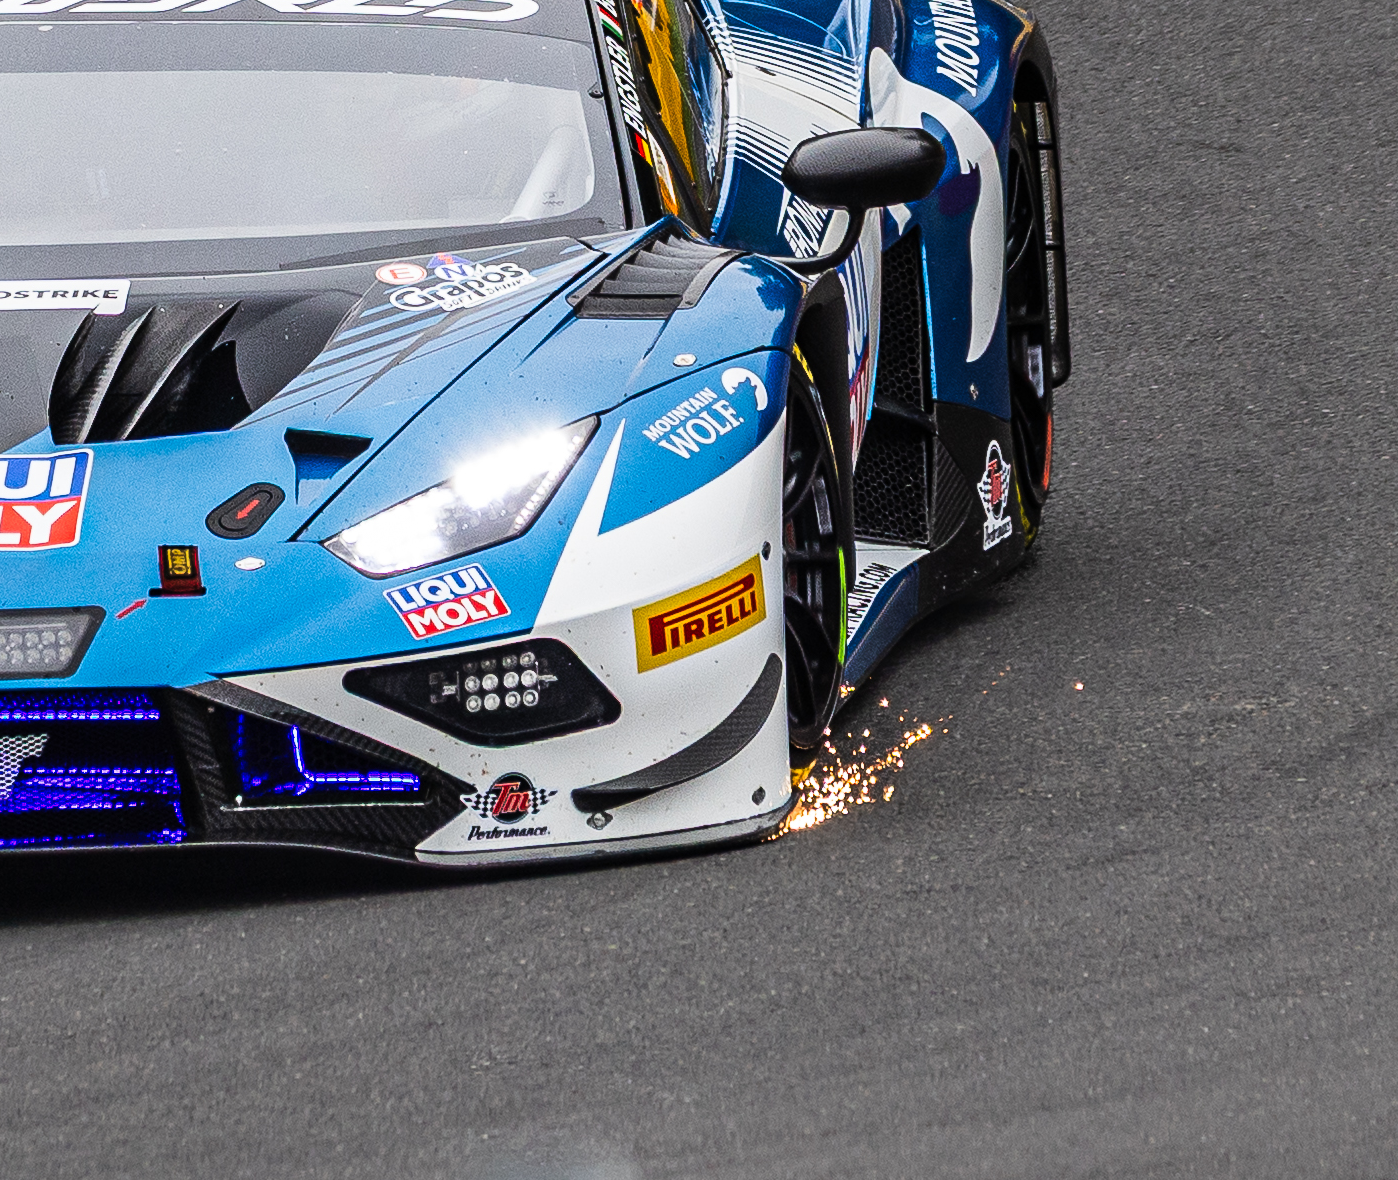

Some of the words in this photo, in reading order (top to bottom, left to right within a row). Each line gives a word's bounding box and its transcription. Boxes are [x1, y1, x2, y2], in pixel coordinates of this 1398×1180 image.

[605, 35, 648, 140] ENGSTLER
[642, 386, 718, 442] MOUNTAIN
[390, 567, 489, 612] LIQUI
[407, 590, 499, 636] MOLY
[648, 572, 758, 657] PIRELLI
